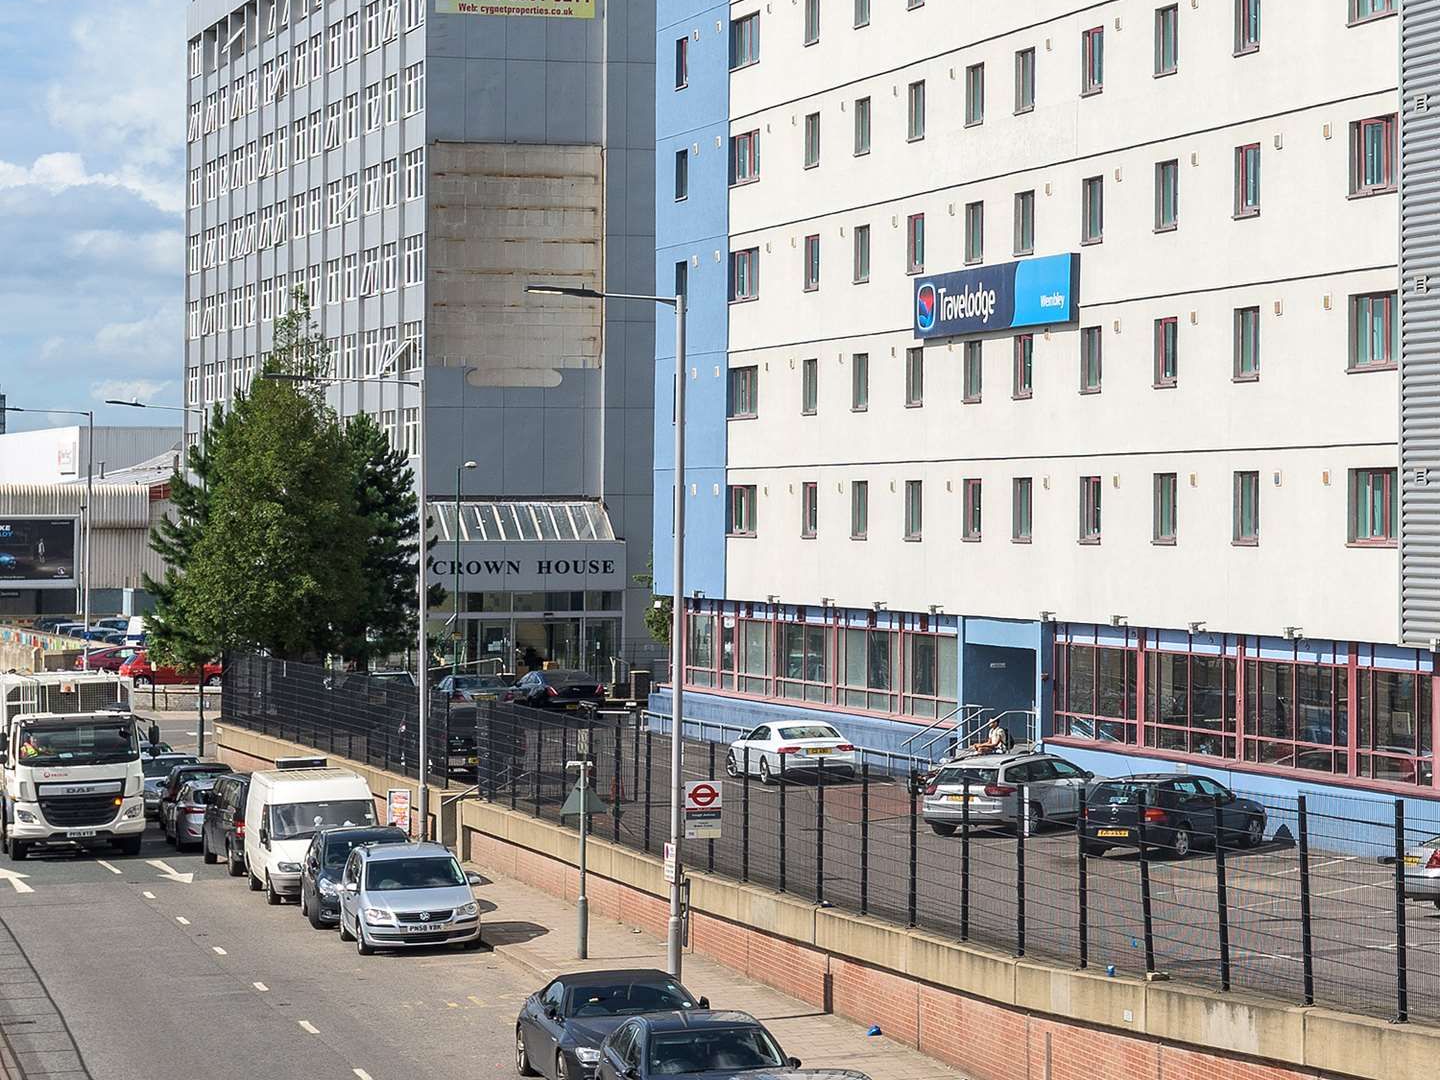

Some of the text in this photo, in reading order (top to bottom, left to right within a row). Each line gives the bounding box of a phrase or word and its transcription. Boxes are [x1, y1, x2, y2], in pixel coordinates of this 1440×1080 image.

[938, 282, 1065, 323] Travelodge Wembley
[432, 559, 615, 575] CROWN HOUSE
